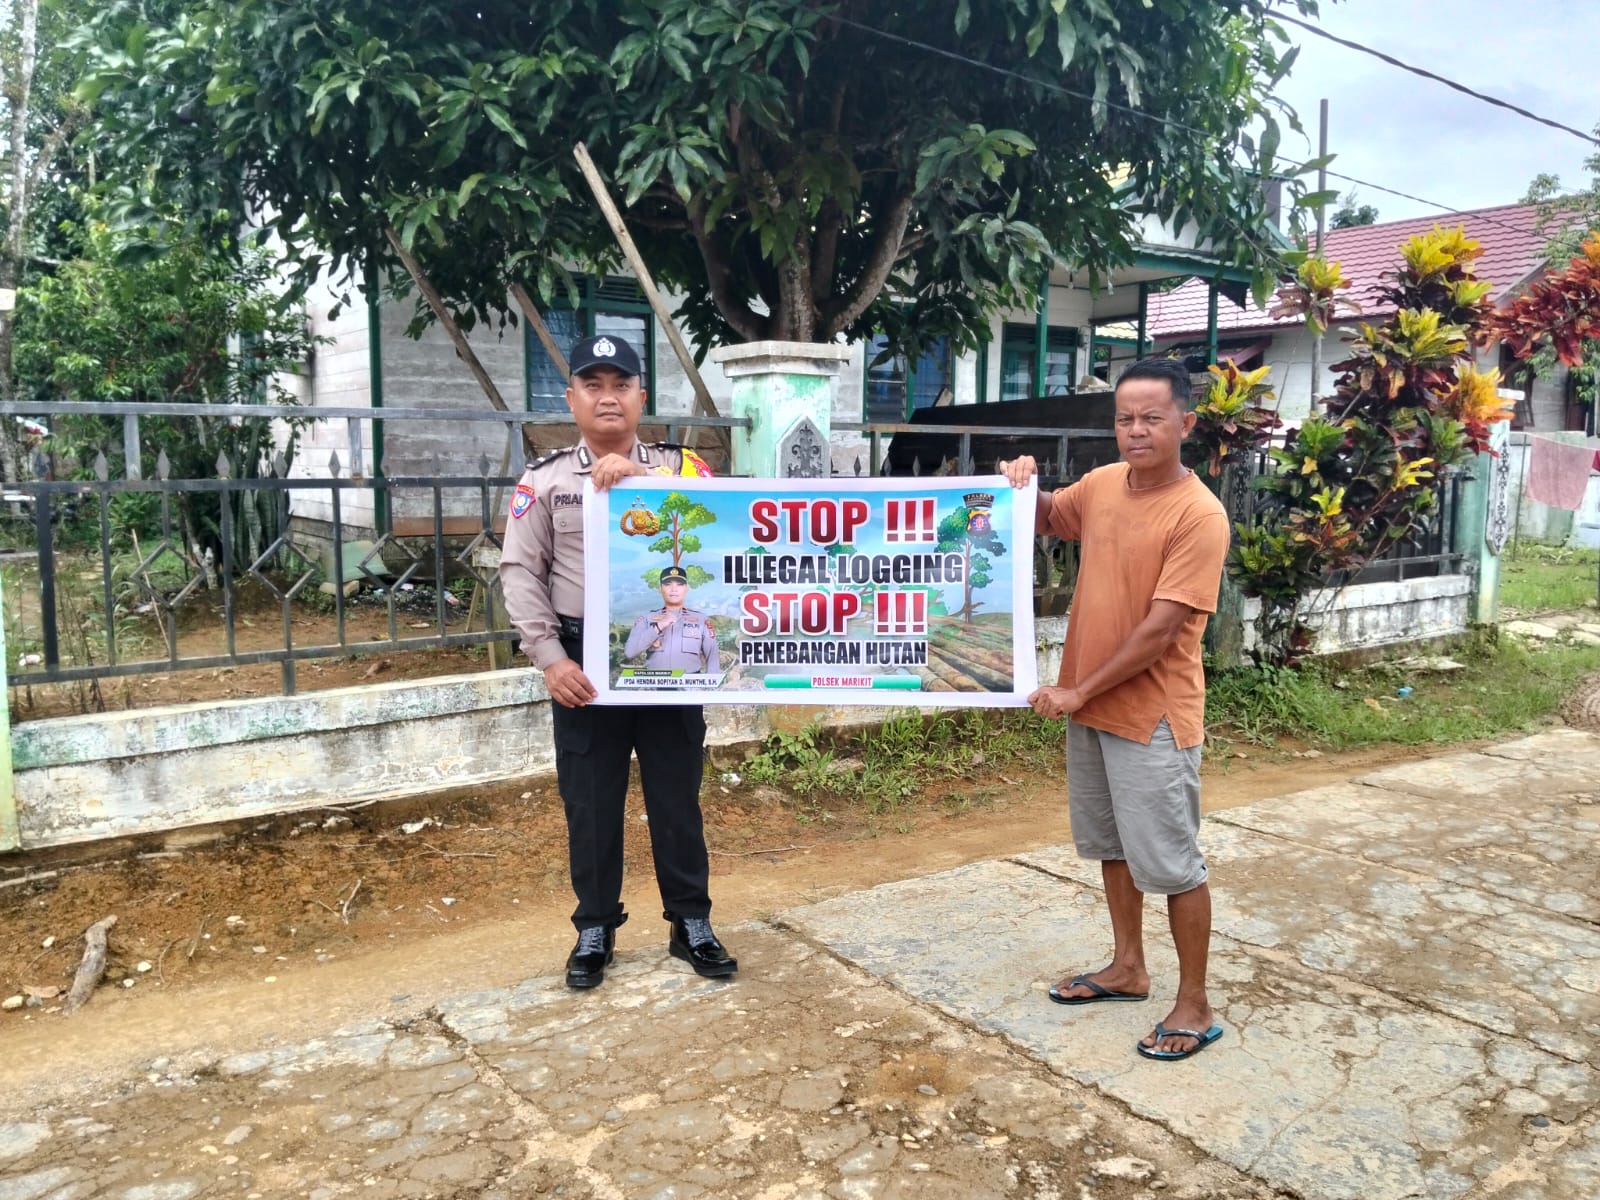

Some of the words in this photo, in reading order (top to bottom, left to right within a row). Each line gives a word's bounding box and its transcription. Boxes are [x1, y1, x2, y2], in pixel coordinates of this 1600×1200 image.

[750, 498, 869, 544] STOP
[885, 498, 936, 543] !!!
[724, 554, 831, 584] ILLEGAL
[837, 553, 964, 584] LOGGING
[742, 592, 860, 635] STOP
[876, 592, 928, 633] !!!
[741, 641, 863, 666] PENEBANGAN
[865, 641, 926, 665] HUTAN
[812, 677, 839, 686] POLSEK
[841, 677, 872, 686] MARIKIT
